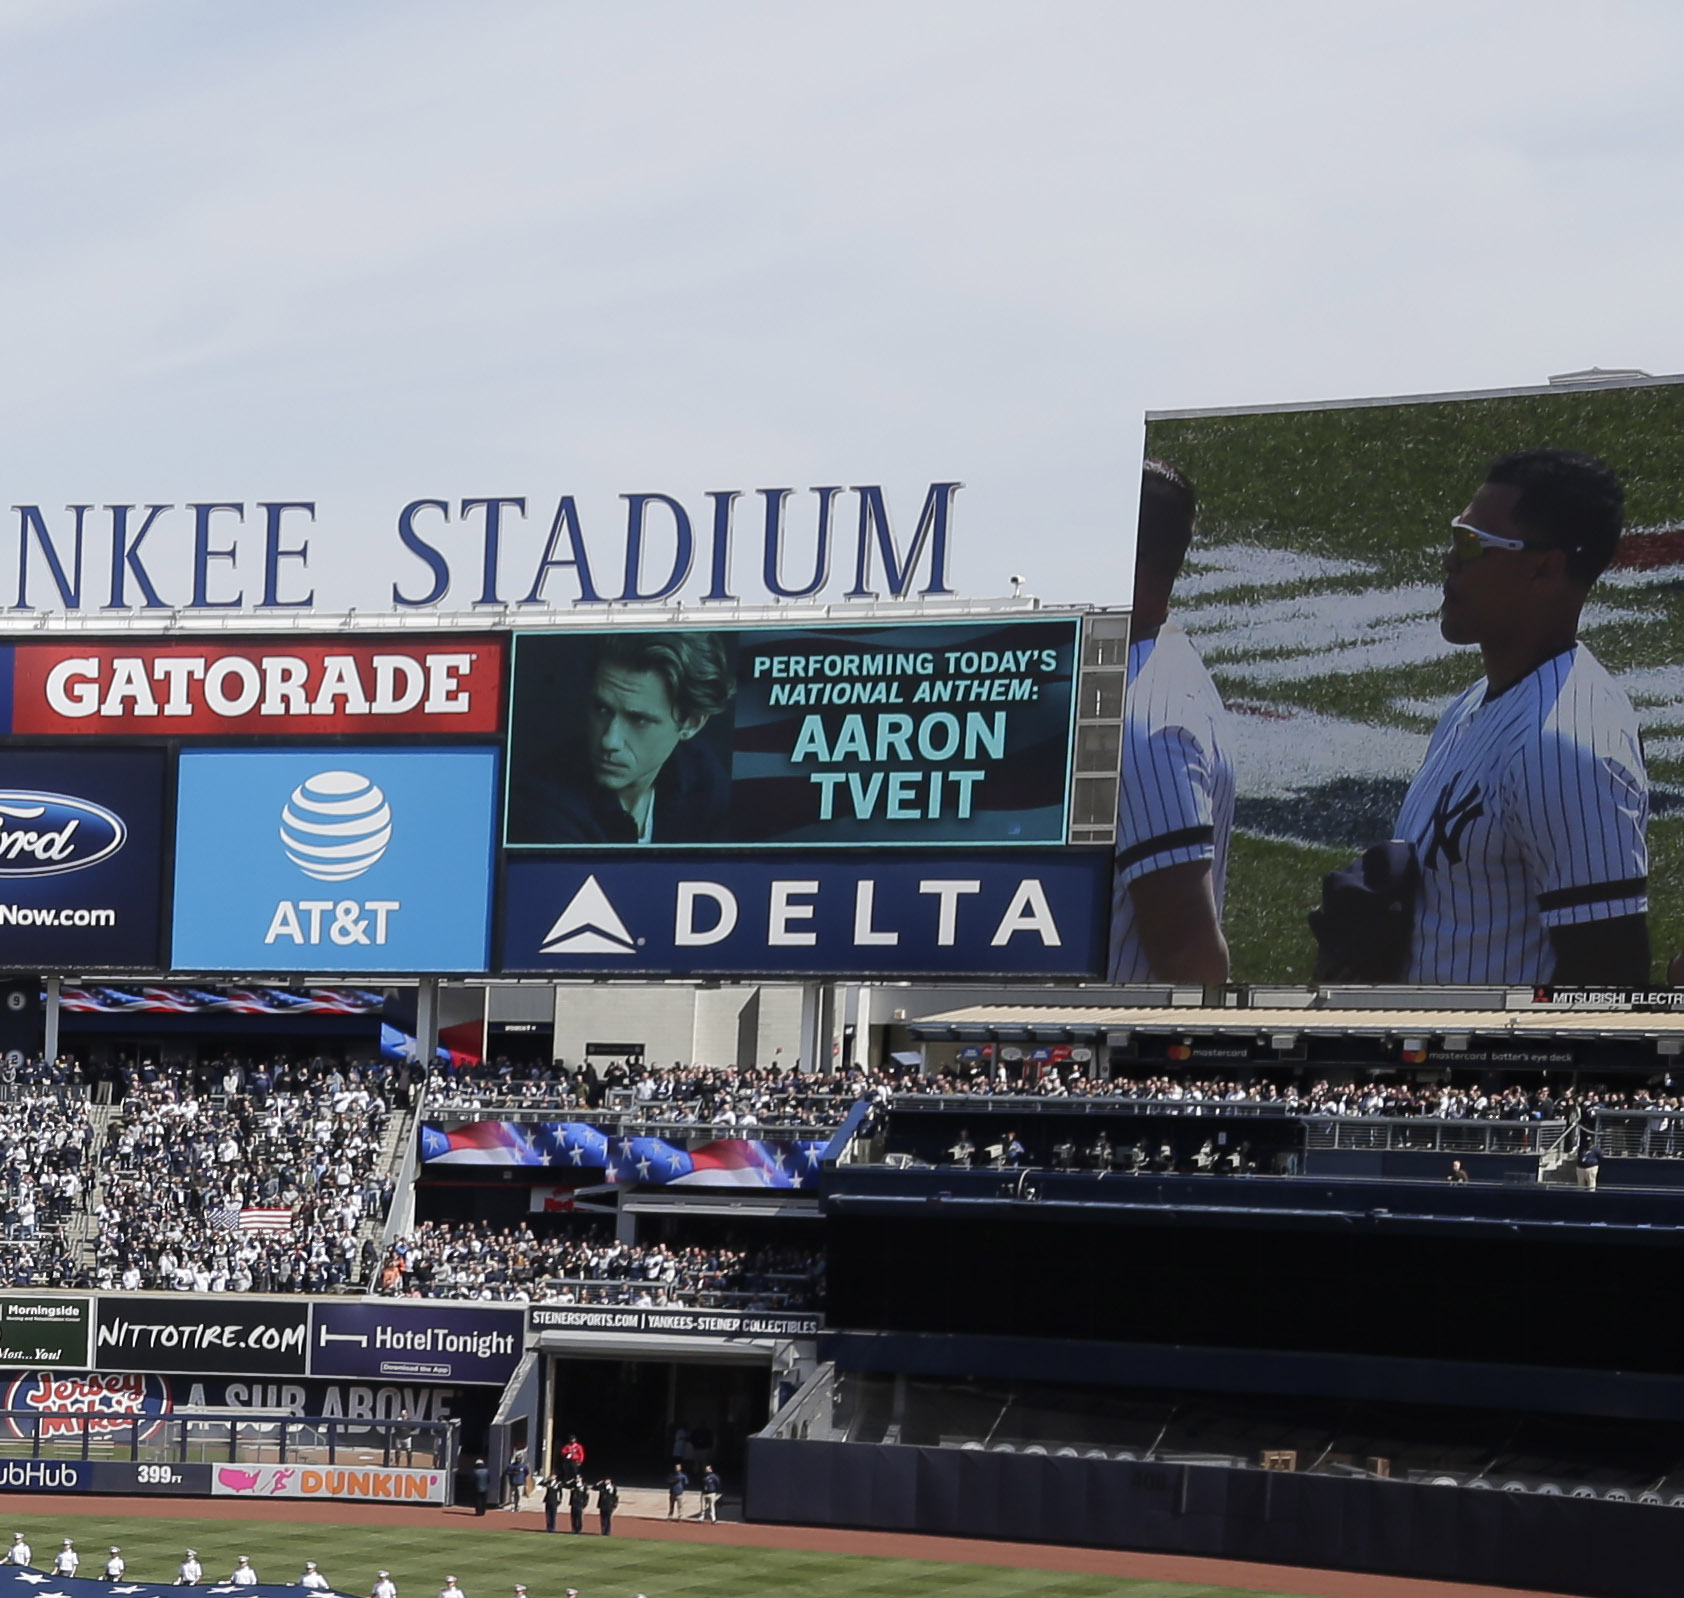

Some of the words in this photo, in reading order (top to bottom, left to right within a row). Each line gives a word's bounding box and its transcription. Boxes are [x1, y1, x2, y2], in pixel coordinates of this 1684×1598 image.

[391, 481, 965, 609] STADIUM
[753, 652, 933, 679] PERFORMING
[944, 649, 1057, 674] TODAY'S
[44, 653, 472, 719] GATORADE
[769, 681, 905, 706] NATIONAL
[912, 678, 1039, 703] ANTHEM:
[790, 710, 1007, 763] AARON
[809, 770, 986, 821] TVEIT
[264, 900, 400, 947] AT&T
[673, 878, 1063, 947] DELTA
[1552, 992, 1626, 1004] MITSUBISHI
[1192, 1047, 1248, 1060] mastercard
[1429, 1050, 1488, 1062] mastercard
[1549, 1051, 1574, 1063] deck
[8, 1304, 80, 1317] Morningside
[532, 1311, 639, 1330] STEINERSPORTS.COM
[647, 1314, 741, 1332] YANKEES-STEINER
[742, 1318, 818, 1335] COLLECTIBLES
[97, 1318, 306, 1356] NITTOTIRE.COM
[34, 1348, 63, 1361] You!
[27, 1371, 146, 1405] Jersey
[318, 1385, 455, 1435] ABOVE
[300, 1470, 438, 1499] DUNKIN'
